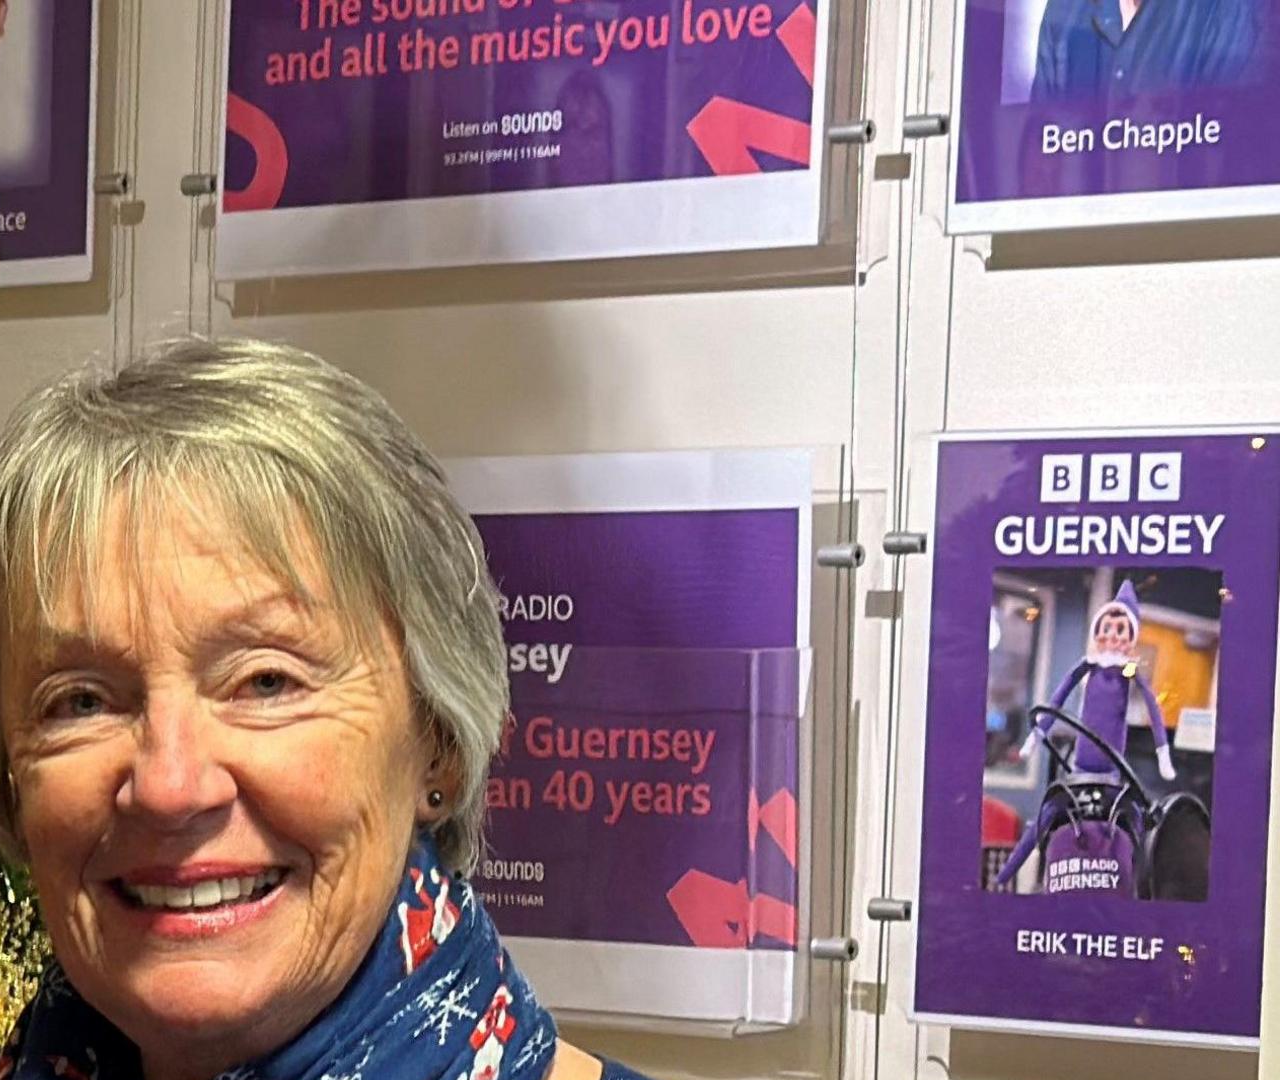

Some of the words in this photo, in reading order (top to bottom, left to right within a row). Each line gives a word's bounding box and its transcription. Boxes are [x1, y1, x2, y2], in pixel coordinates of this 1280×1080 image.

[265, 37, 332, 85] and
[341, 31, 387, 77] all
[397, 28, 459, 73] the
[470, 13, 584, 66] music
[592, 14, 670, 67] you
[681, 0, 773, 45] love
[442, 121, 480, 139] Listen
[481, 120, 499, 136] on
[1041, 124, 1094, 154] Ben
[1102, 113, 1221, 155] Chapple
[1047, 457, 1176, 498] BBC
[993, 513, 1226, 556] GUERNSEY
[525, 716, 716, 774] Guernsey
[542, 769, 595, 812] 40
[603, 778, 712, 826] years
[1049, 873, 1120, 893] GUERNSEY
[1081, 858, 1120, 873] RADIO
[1017, 930, 1067, 955] ERIK
[1072, 933, 1118, 958] THE
[1123, 936, 1164, 961] ELF
